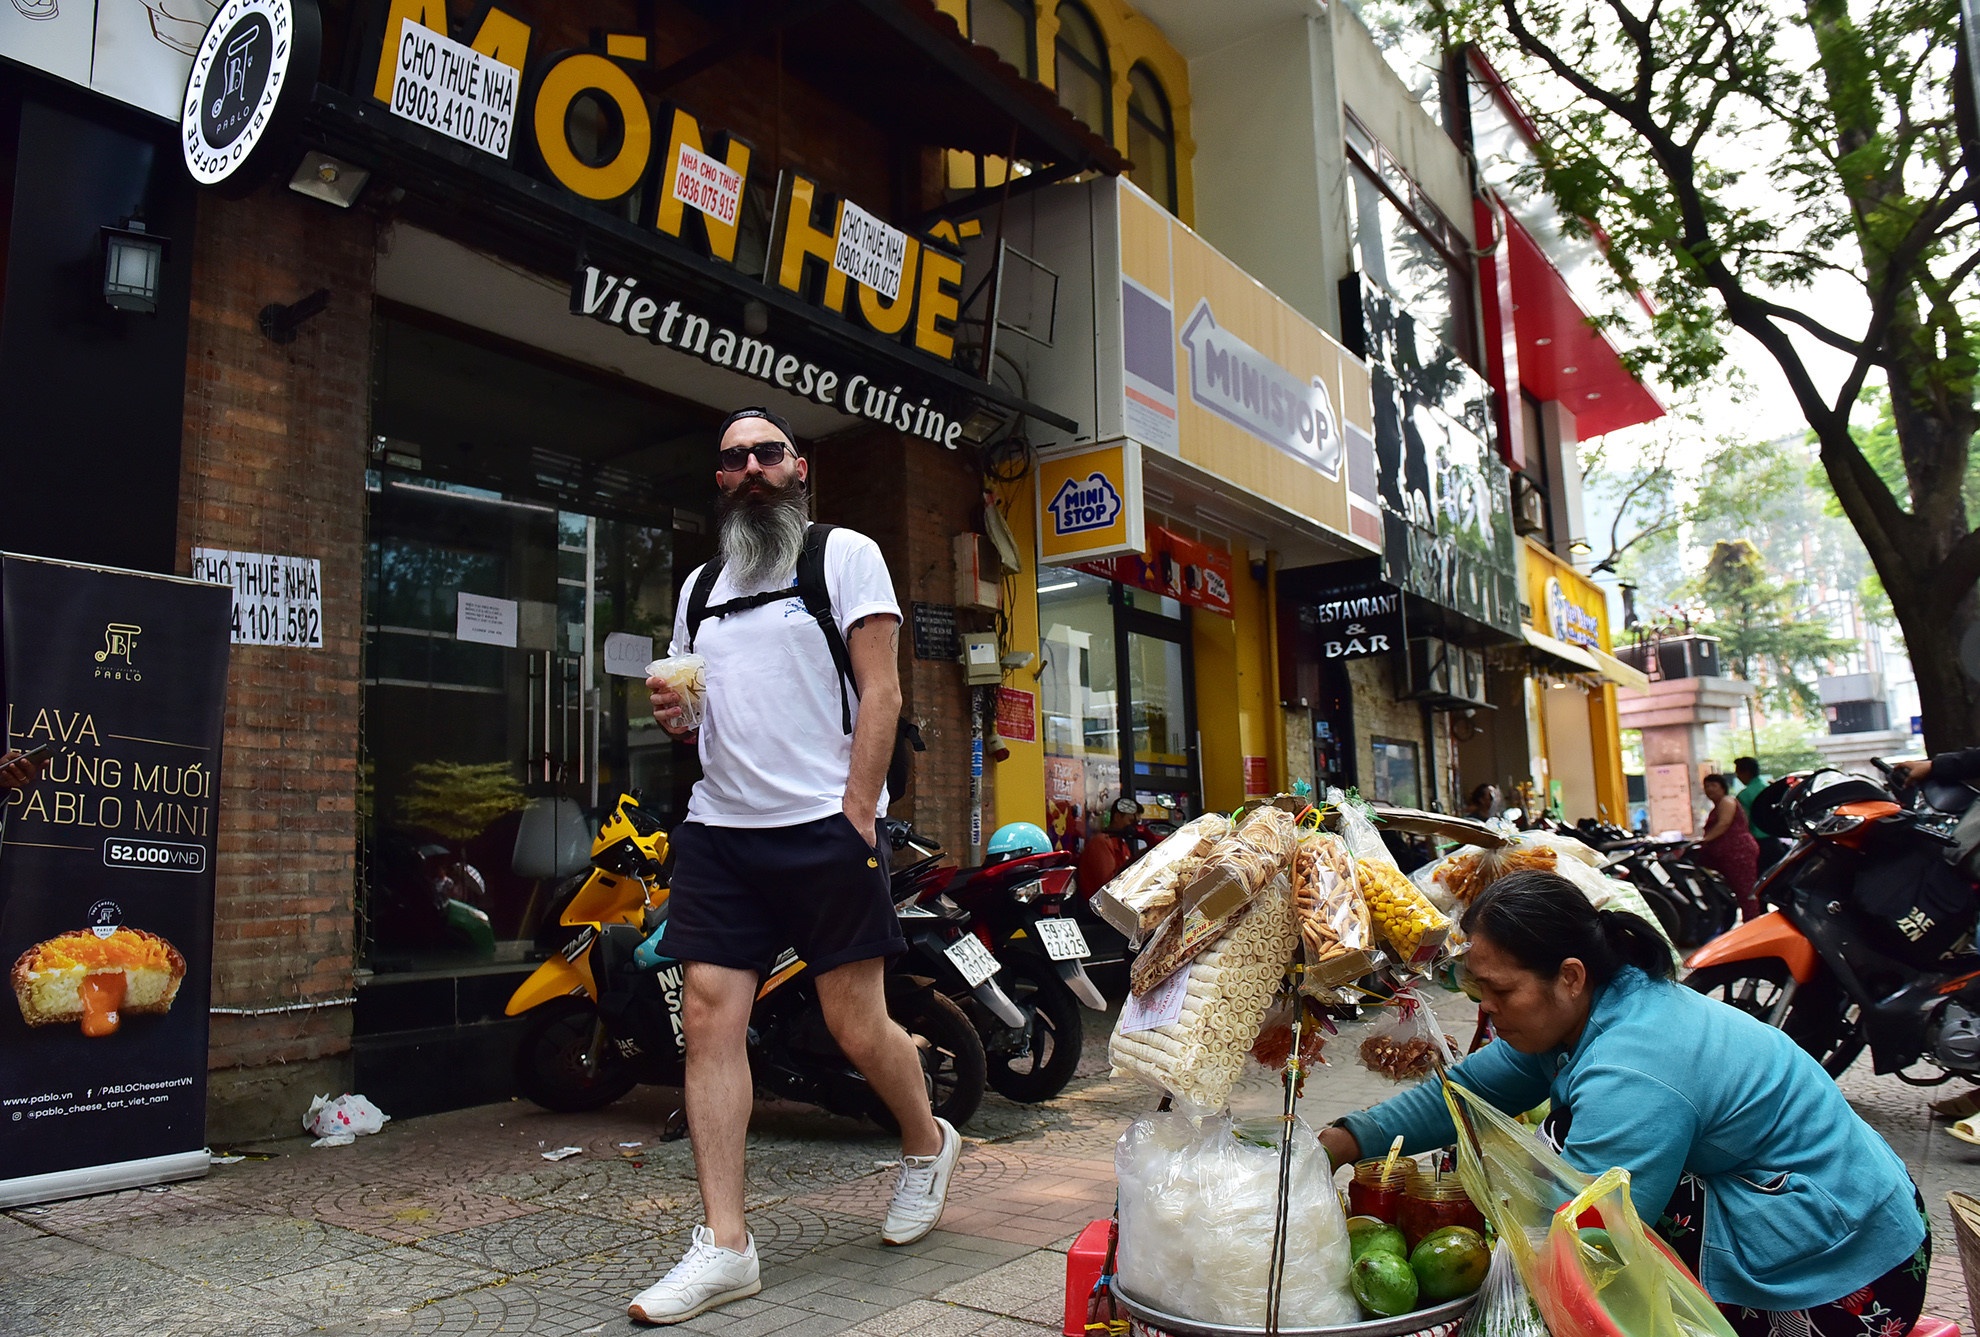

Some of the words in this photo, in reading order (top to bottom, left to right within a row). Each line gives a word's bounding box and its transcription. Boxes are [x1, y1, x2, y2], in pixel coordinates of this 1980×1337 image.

[402, 32, 436, 81] CHO
[440, 54, 480, 101] THUÊ
[482, 68, 513, 116] NHÀ
[216, 105, 250, 134] PABLO
[396, 76, 508, 154] 0903.410.073
[681, 152, 698, 172] NHÀ
[700, 162, 717, 182] CHO
[719, 171, 740, 194] THUÊ
[677, 172, 700, 203] 0936
[701, 184, 719, 212] 075
[718, 193, 735, 221] 915
[842, 209, 862, 244] CHO
[862, 222, 886, 258] THUÊ
[884, 234, 904, 269] NHÀ
[837, 242, 900, 297] 0903.410.073
[582, 265, 838, 402] Vietnamese
[844, 375, 963, 450] Cuisine
[1205, 338, 1328, 451] MINISTOP
[1064, 504, 1107, 527] STOP
[1065, 487, 1104, 509] MINI
[236, 556, 280, 598] THUÊ
[285, 560, 319, 601] NHÀ
[1324, 635, 1391, 658] BAR
[1345, 623, 1367, 635] &
[95, 670, 142, 682] PABLO
[8, 703, 100, 747] LAVA
[10, 747, 122, 789] ỨNG
[134, 800, 209, 837] MINI
[110, 845, 200, 866] 52.000VNĐ
[3, 1092, 73, 1106] www.pablo.vn
[27, 1094, 169, 1120] @pablo_cheese_tart_viet_nam
